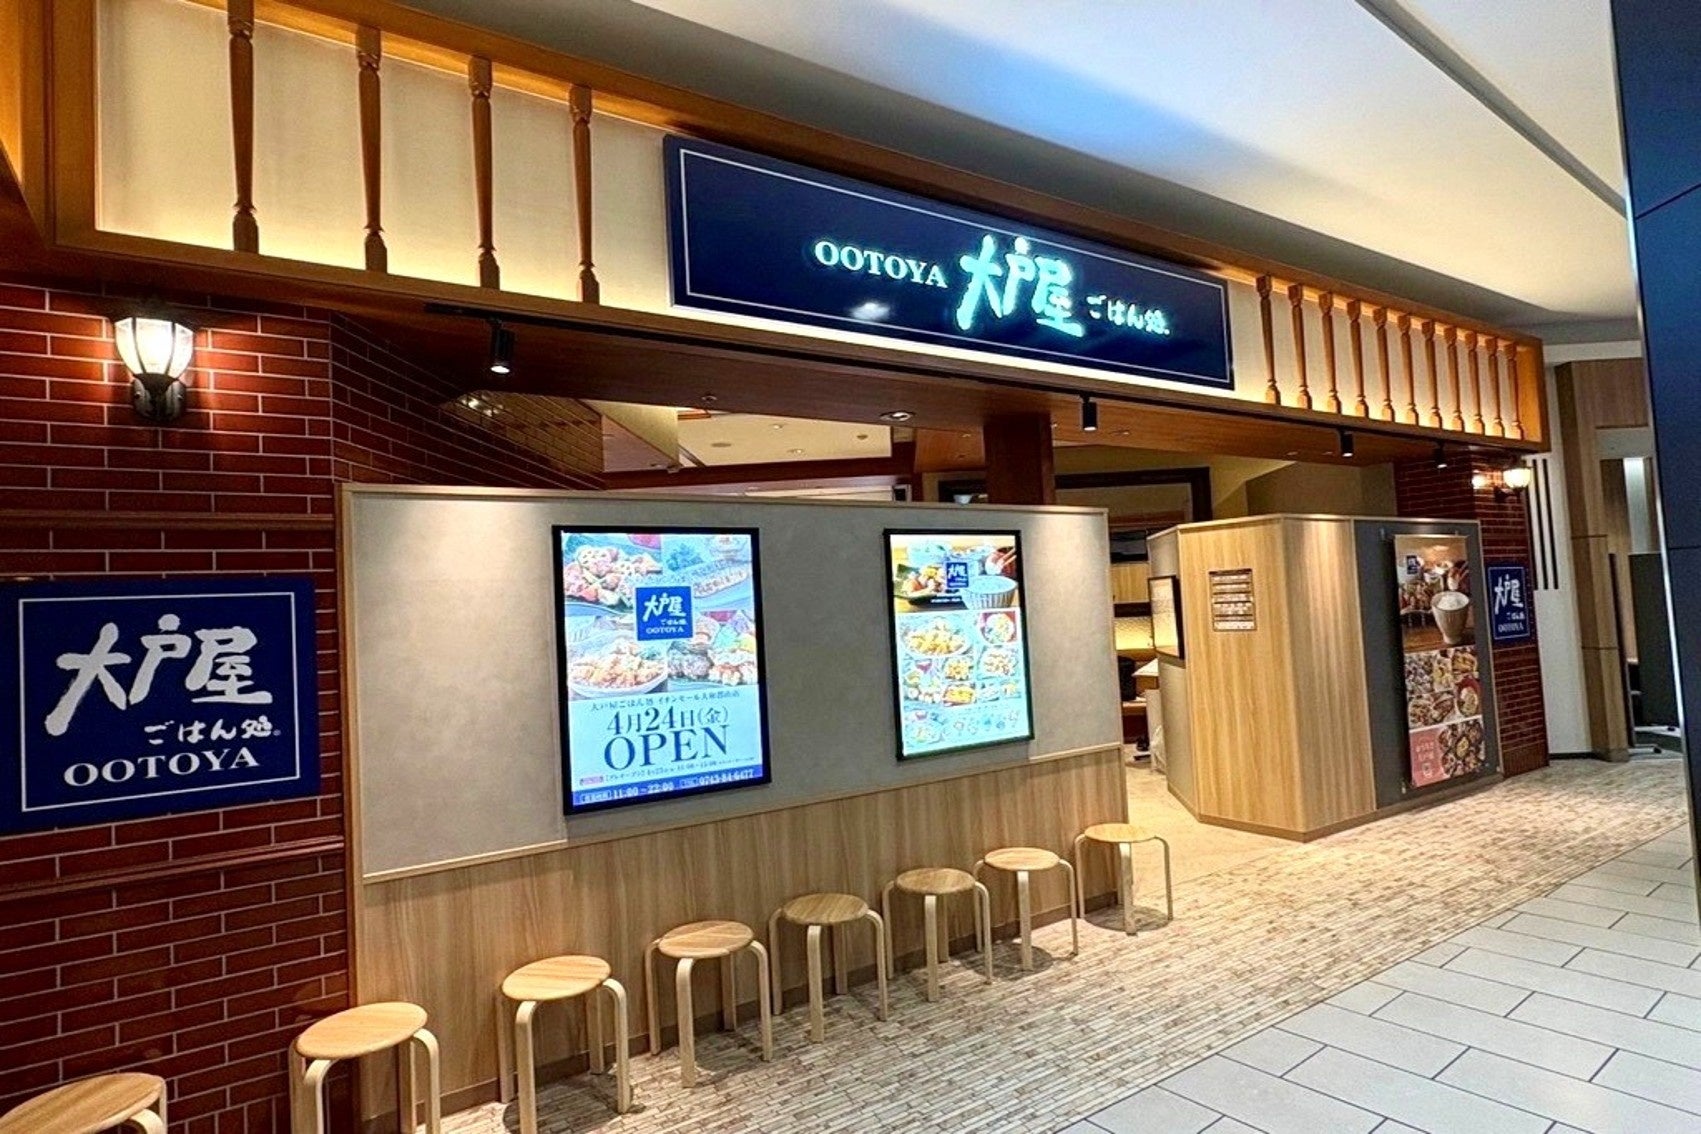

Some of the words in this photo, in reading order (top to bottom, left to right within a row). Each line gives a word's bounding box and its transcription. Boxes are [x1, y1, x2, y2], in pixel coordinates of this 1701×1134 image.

[814, 241, 948, 289] OOTOYA
[955, 235, 1085, 338] 大戸屋
[642, 592, 687, 622] 大戸屋
[1494, 573, 1524, 615] 大戸屋
[44, 612, 274, 736] 大戸屋
[63, 747, 260, 787] OOTOYA
[604, 724, 730, 771] OPEN
